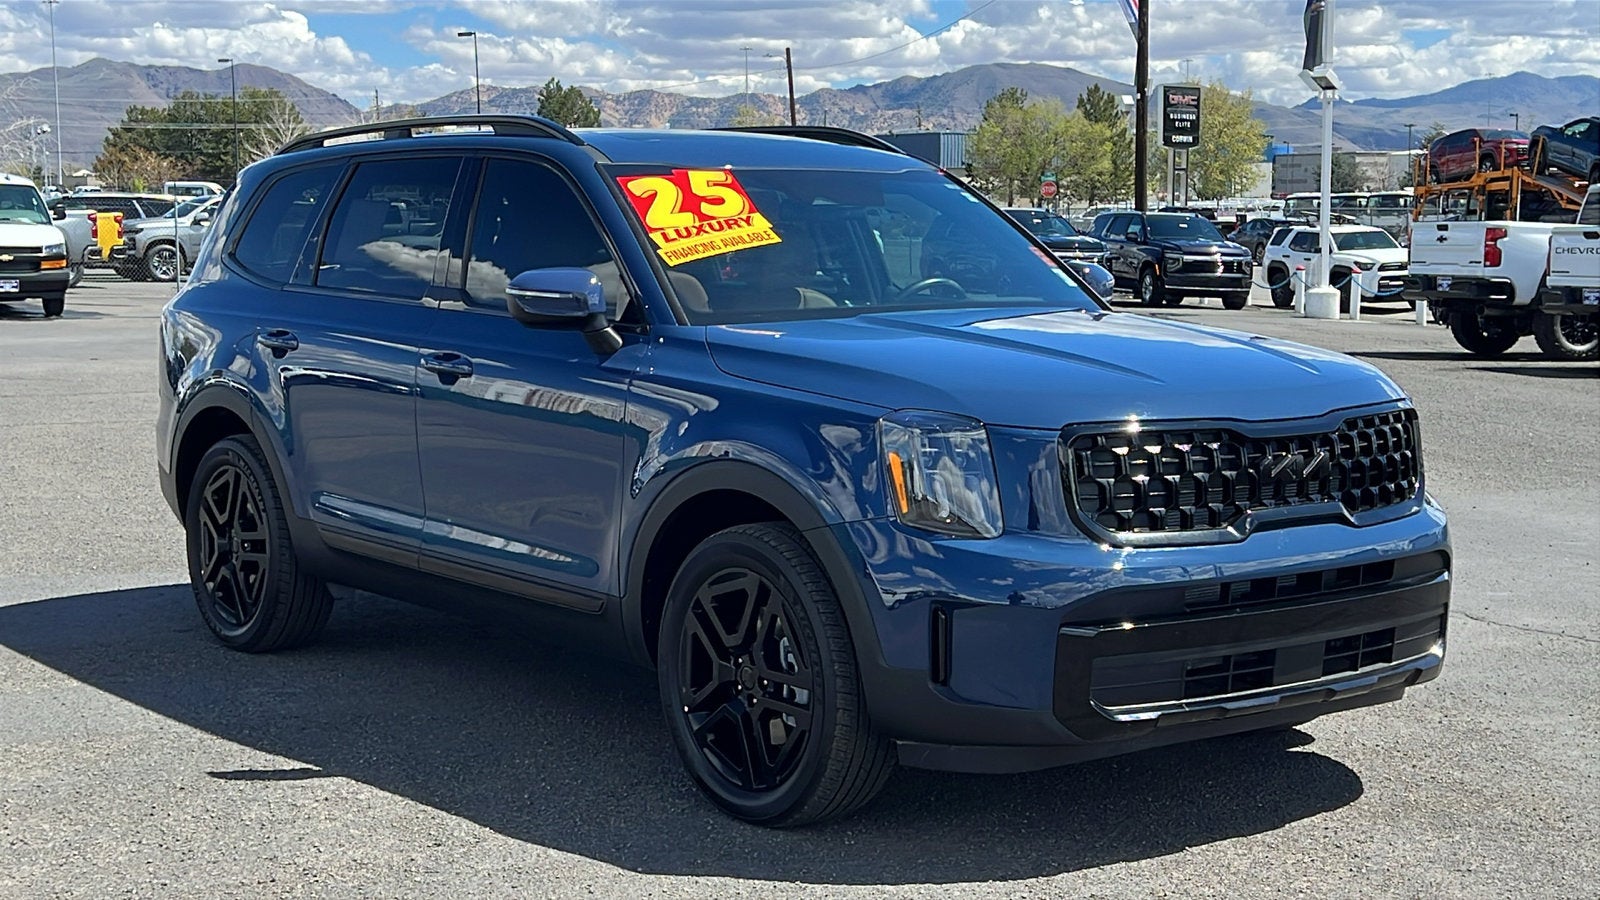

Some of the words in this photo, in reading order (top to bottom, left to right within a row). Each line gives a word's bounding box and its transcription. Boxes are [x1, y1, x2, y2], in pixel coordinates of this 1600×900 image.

[1169, 94, 1197, 104] GMC
[627, 170, 750, 228] 25
[660, 215, 754, 243] LUXURY
[664, 240, 720, 262] FINANCING
[722, 230, 775, 249] AVAILABLE
